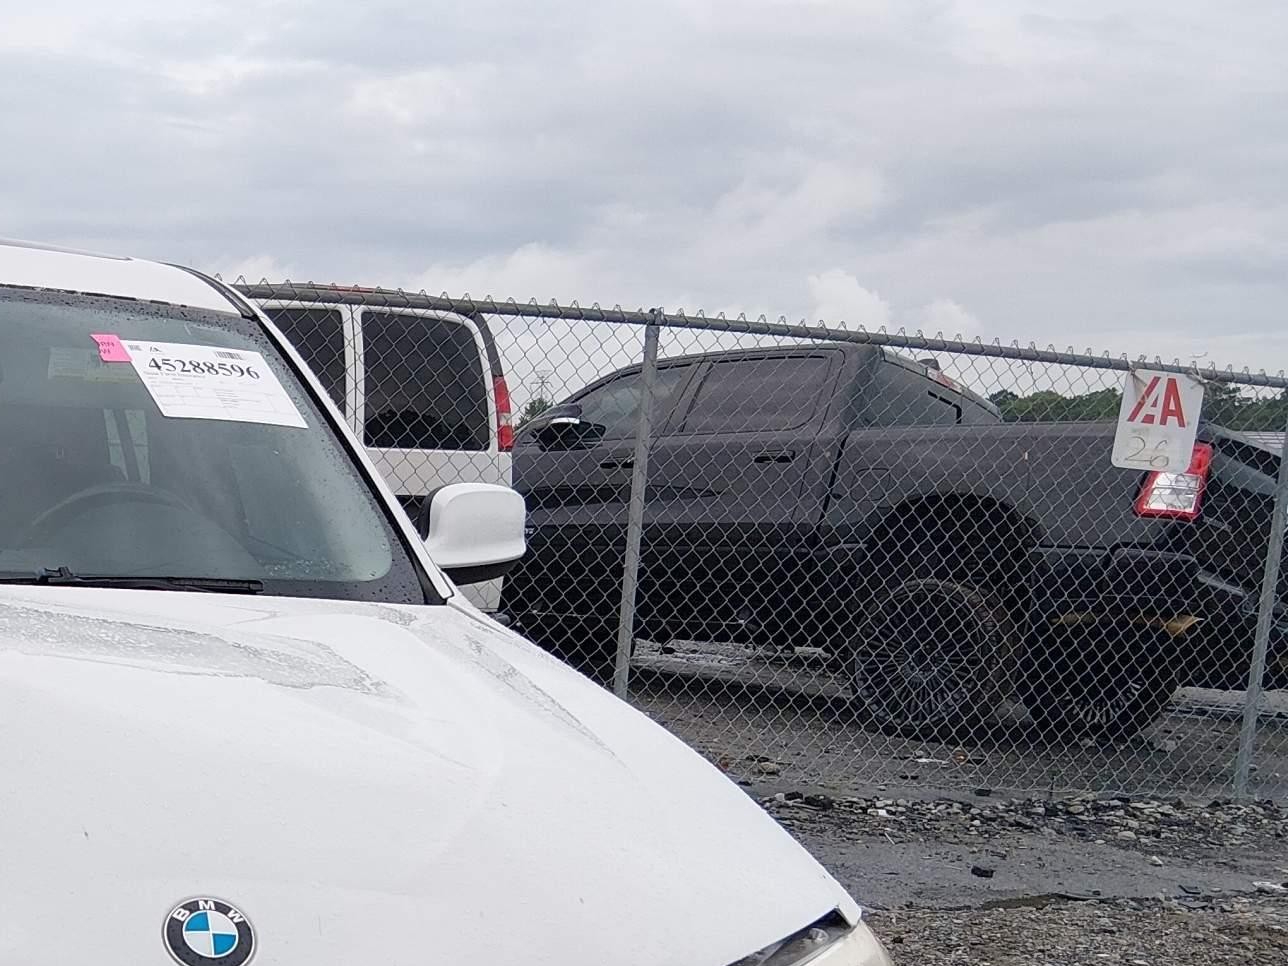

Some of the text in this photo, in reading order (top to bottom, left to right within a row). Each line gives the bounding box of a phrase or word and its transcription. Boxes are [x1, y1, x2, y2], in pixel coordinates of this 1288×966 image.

[148, 357, 260, 380] 45288596
[1124, 435, 1170, 468] 26
[172, 900, 244, 924] BMW
